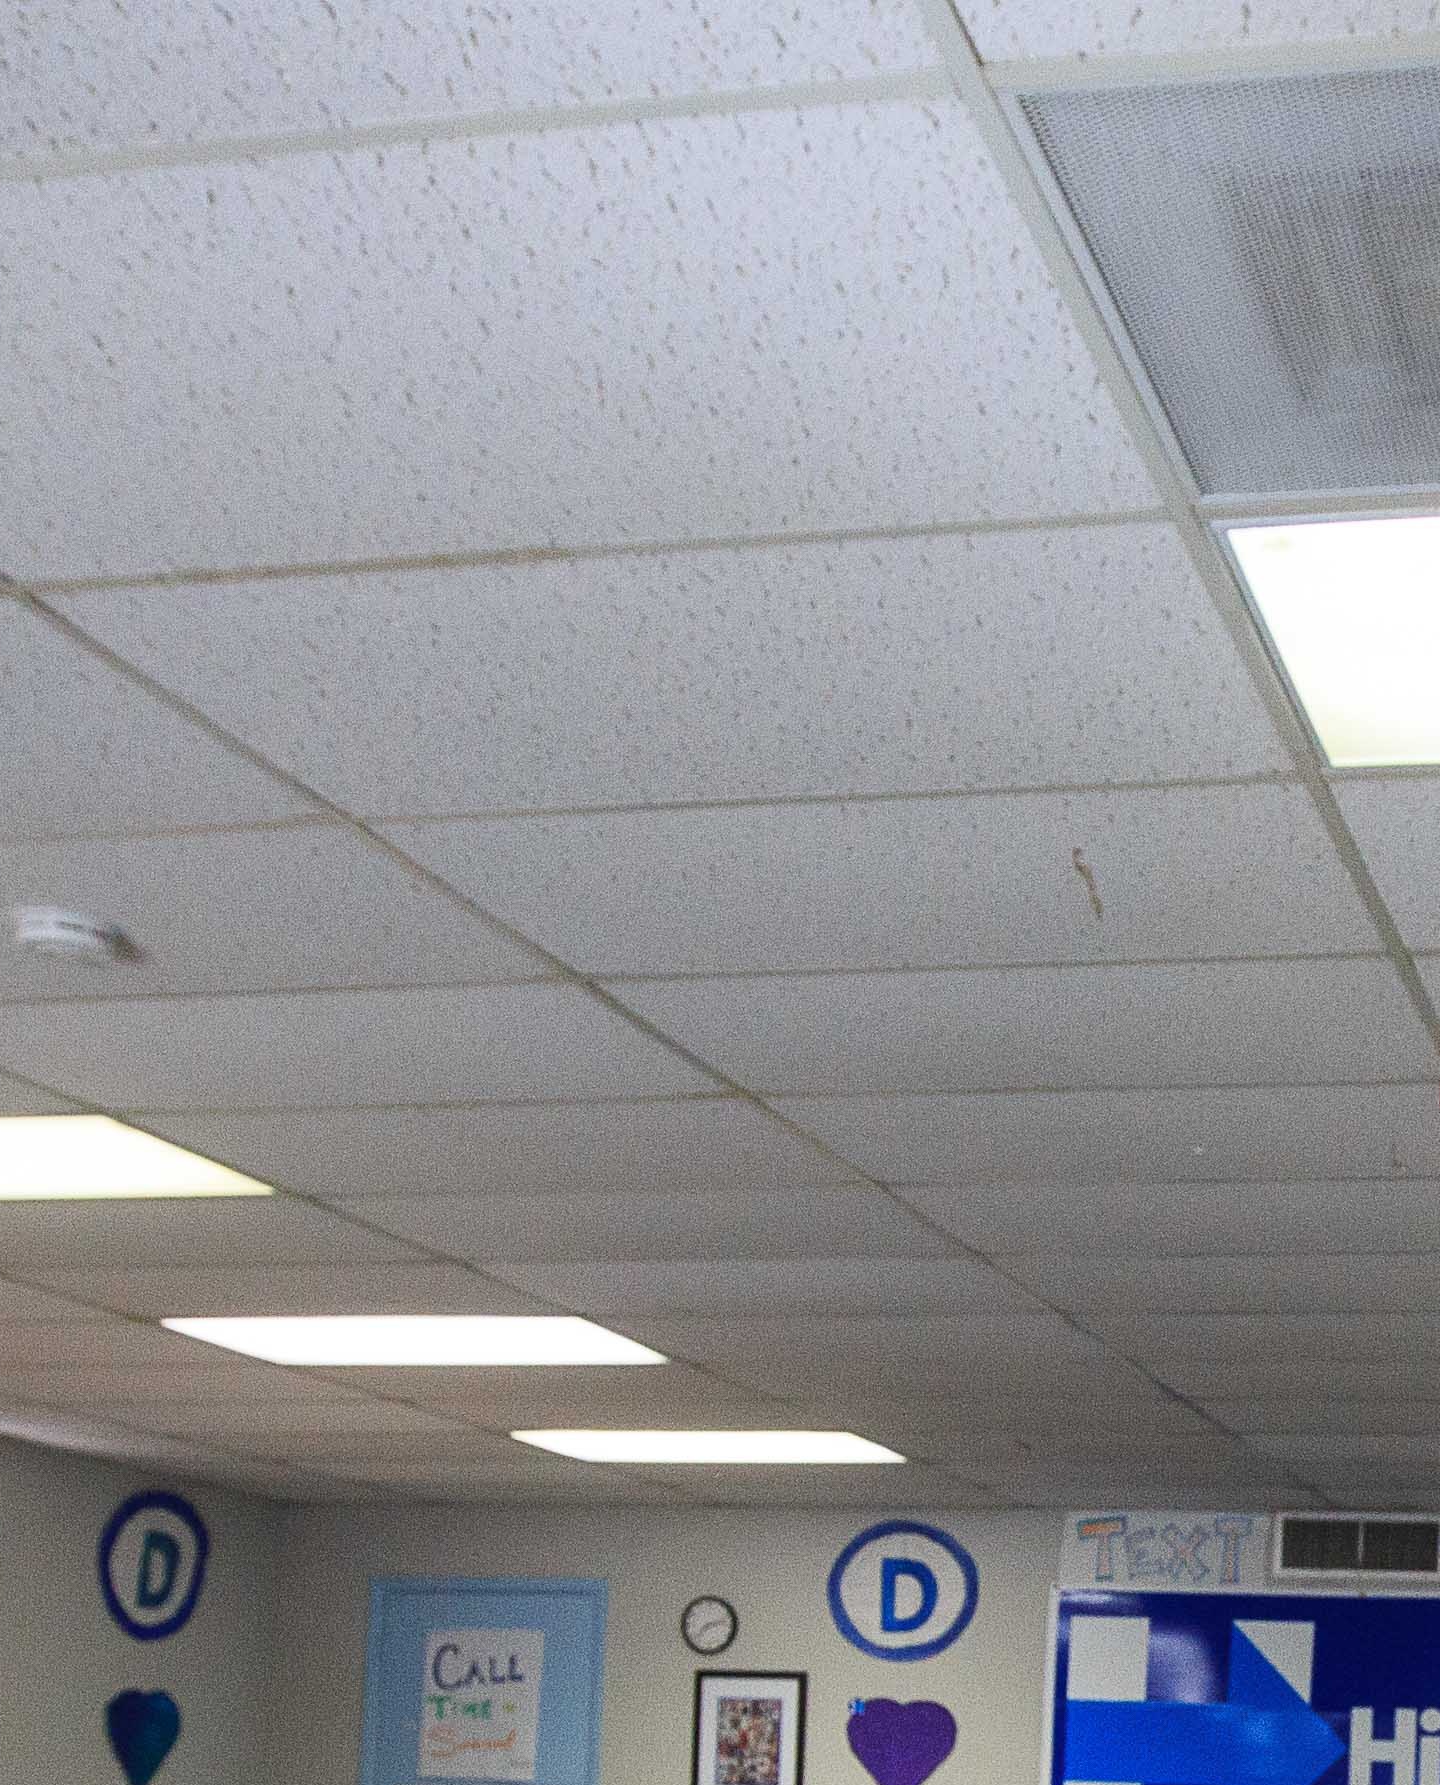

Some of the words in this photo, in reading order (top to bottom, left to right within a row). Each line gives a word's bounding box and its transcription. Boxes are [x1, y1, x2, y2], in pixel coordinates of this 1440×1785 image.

[133, 1529, 180, 1608] D
[1077, 1515, 1252, 1584] TEXT
[880, 1557, 938, 1633] D
[432, 1642, 524, 1690] CALL
